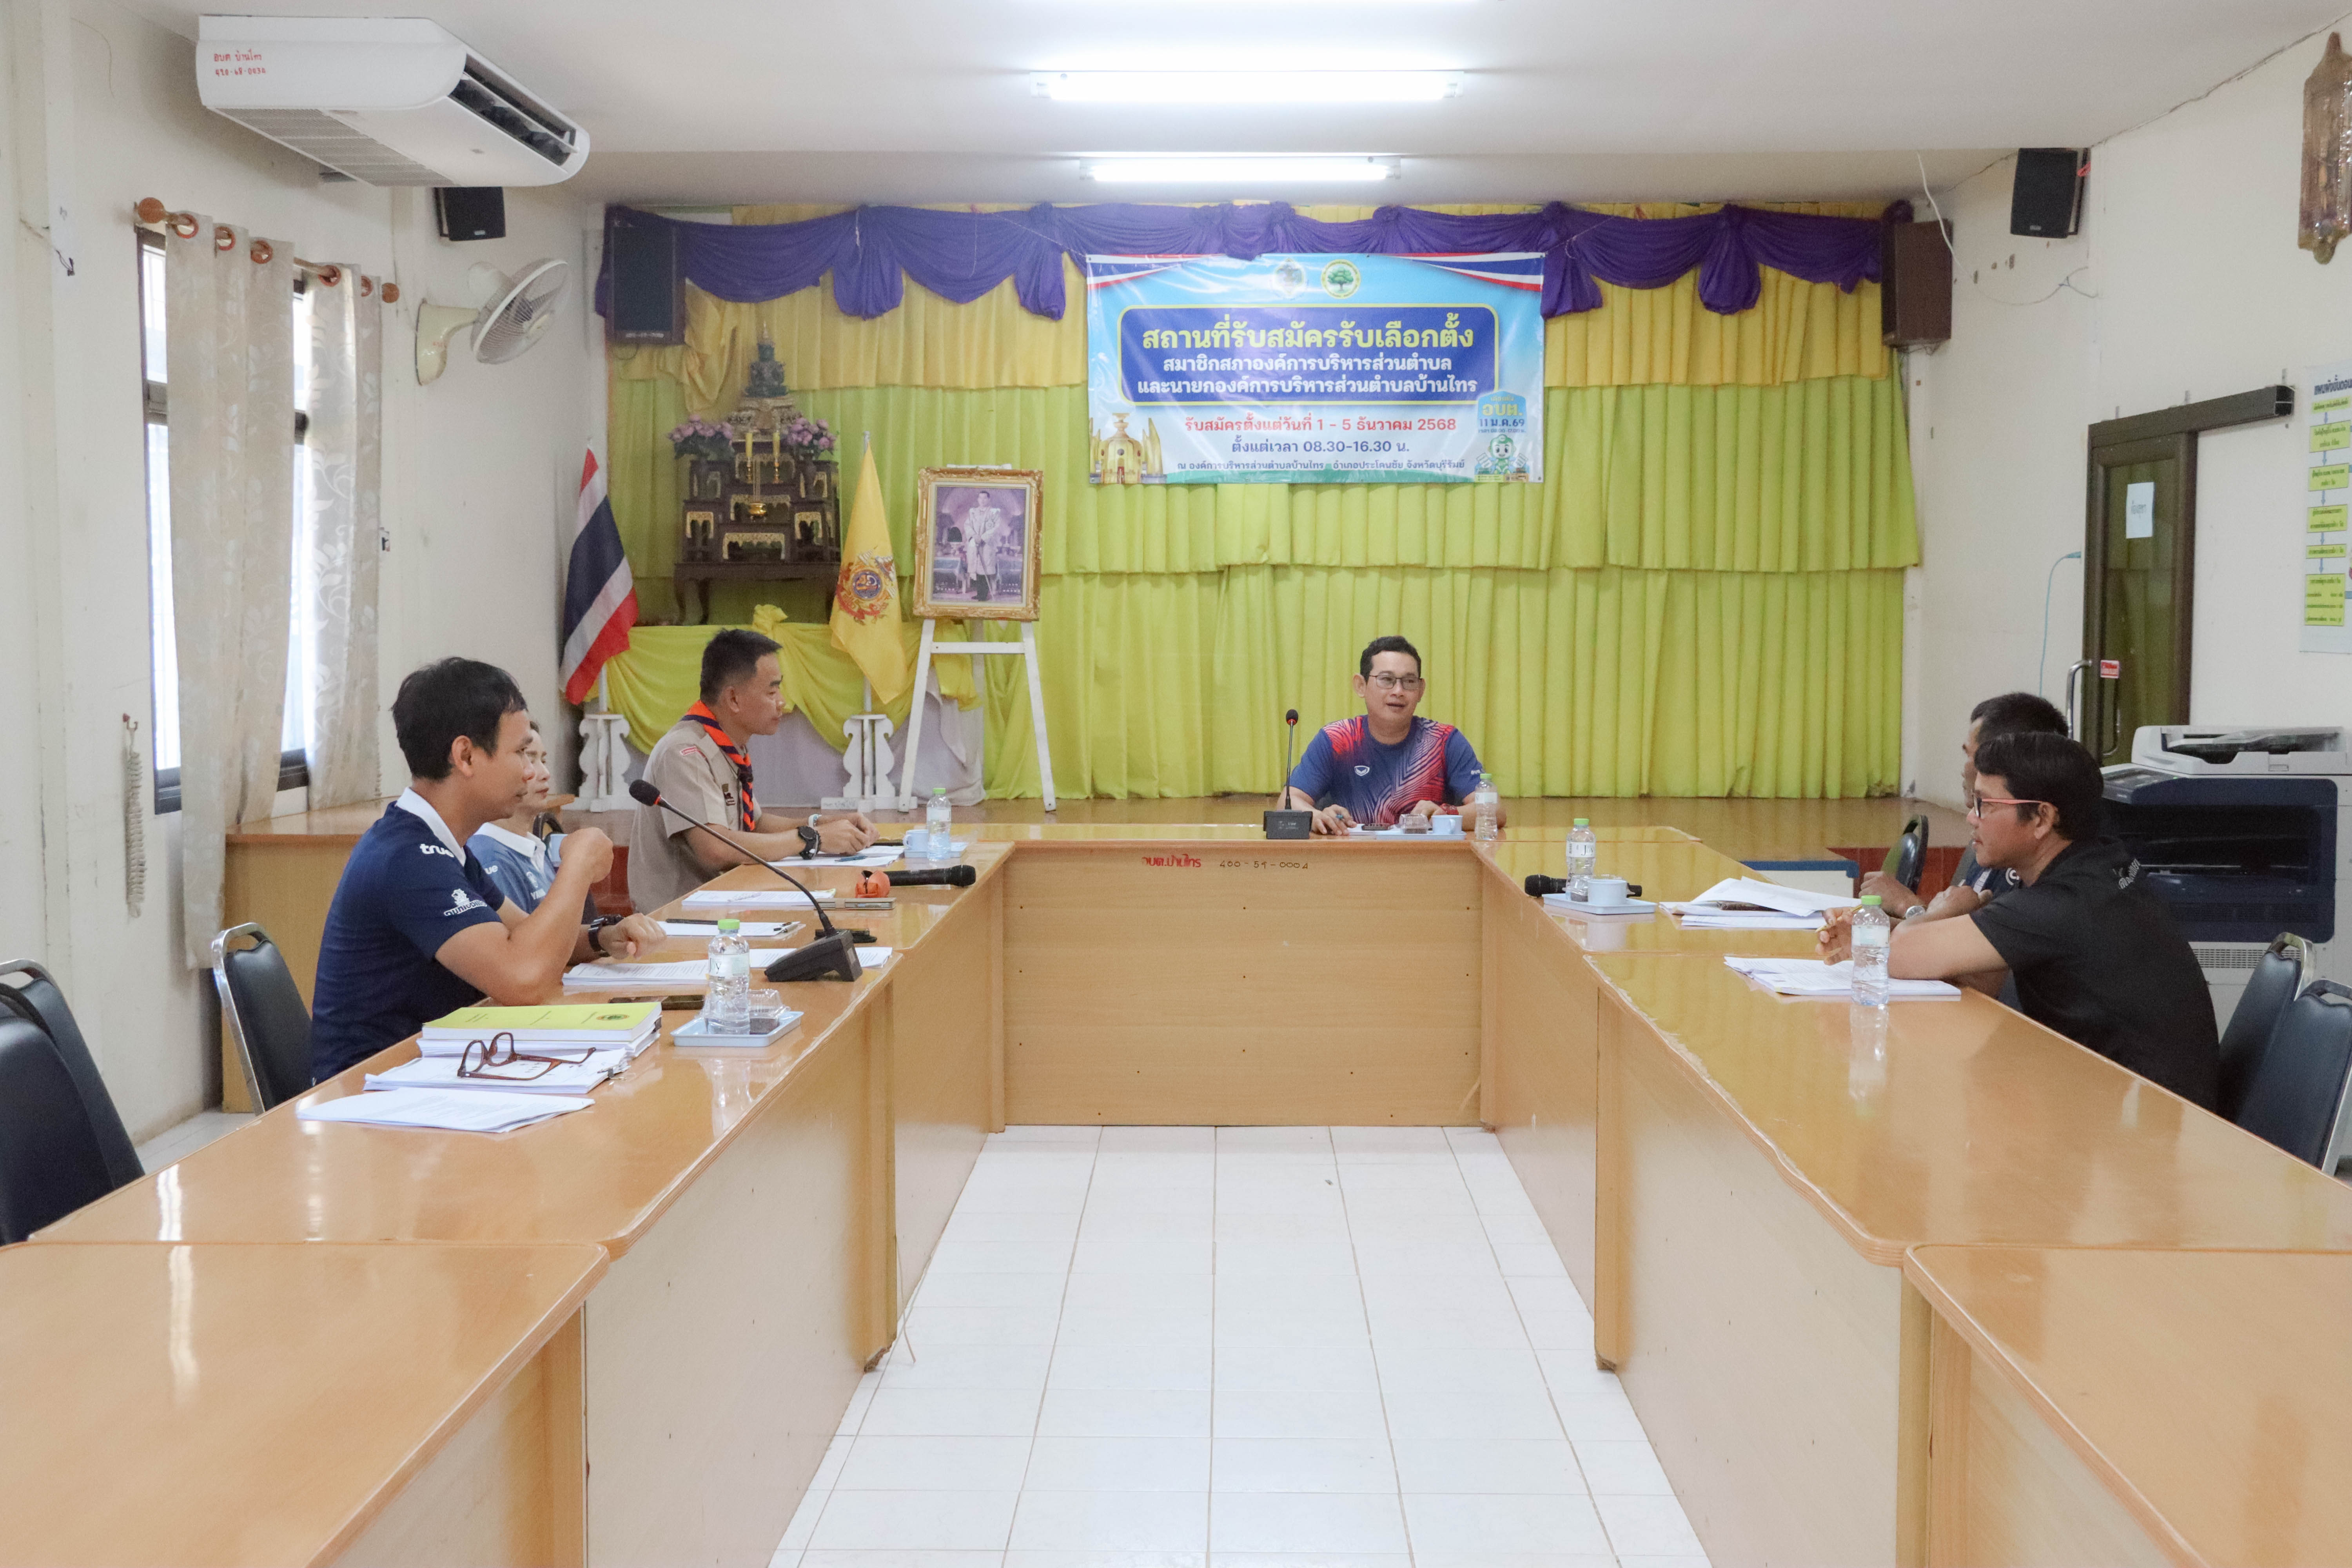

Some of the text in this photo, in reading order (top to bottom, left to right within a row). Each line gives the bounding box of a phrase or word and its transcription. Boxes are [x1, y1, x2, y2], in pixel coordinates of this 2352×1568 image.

[1143, 312, 1474, 348] สถานที่รับสมัครรับเลือกตั้ง
[1163, 352, 1452, 371] สมาชิกสภาองค์การบริหารส่วนตำบล
[1138, 374, 1477, 393] และนายกองค์การบริหารส่วนตำบลบ้านไทร
[1482, 403, 1523, 416] อบต.
[1185, 412, 1312, 431] รับสมัครตั้งแต่วันที่
[1318, 419, 1323, 430] 1
[1342, 419, 1351, 430] 5
[1357, 416, 1412, 430] ธันวาคม
[1417, 418, 1456, 430] 2568
[1232, 435, 1410, 452] ตั้งแต่เวลา 08.30-16.30 น.
[1189, 460, 1324, 470] องค์การบริหารส่วนตำบลบ้านไทร
[1333, 460, 1403, 469] อำเภอประโคนชัย
